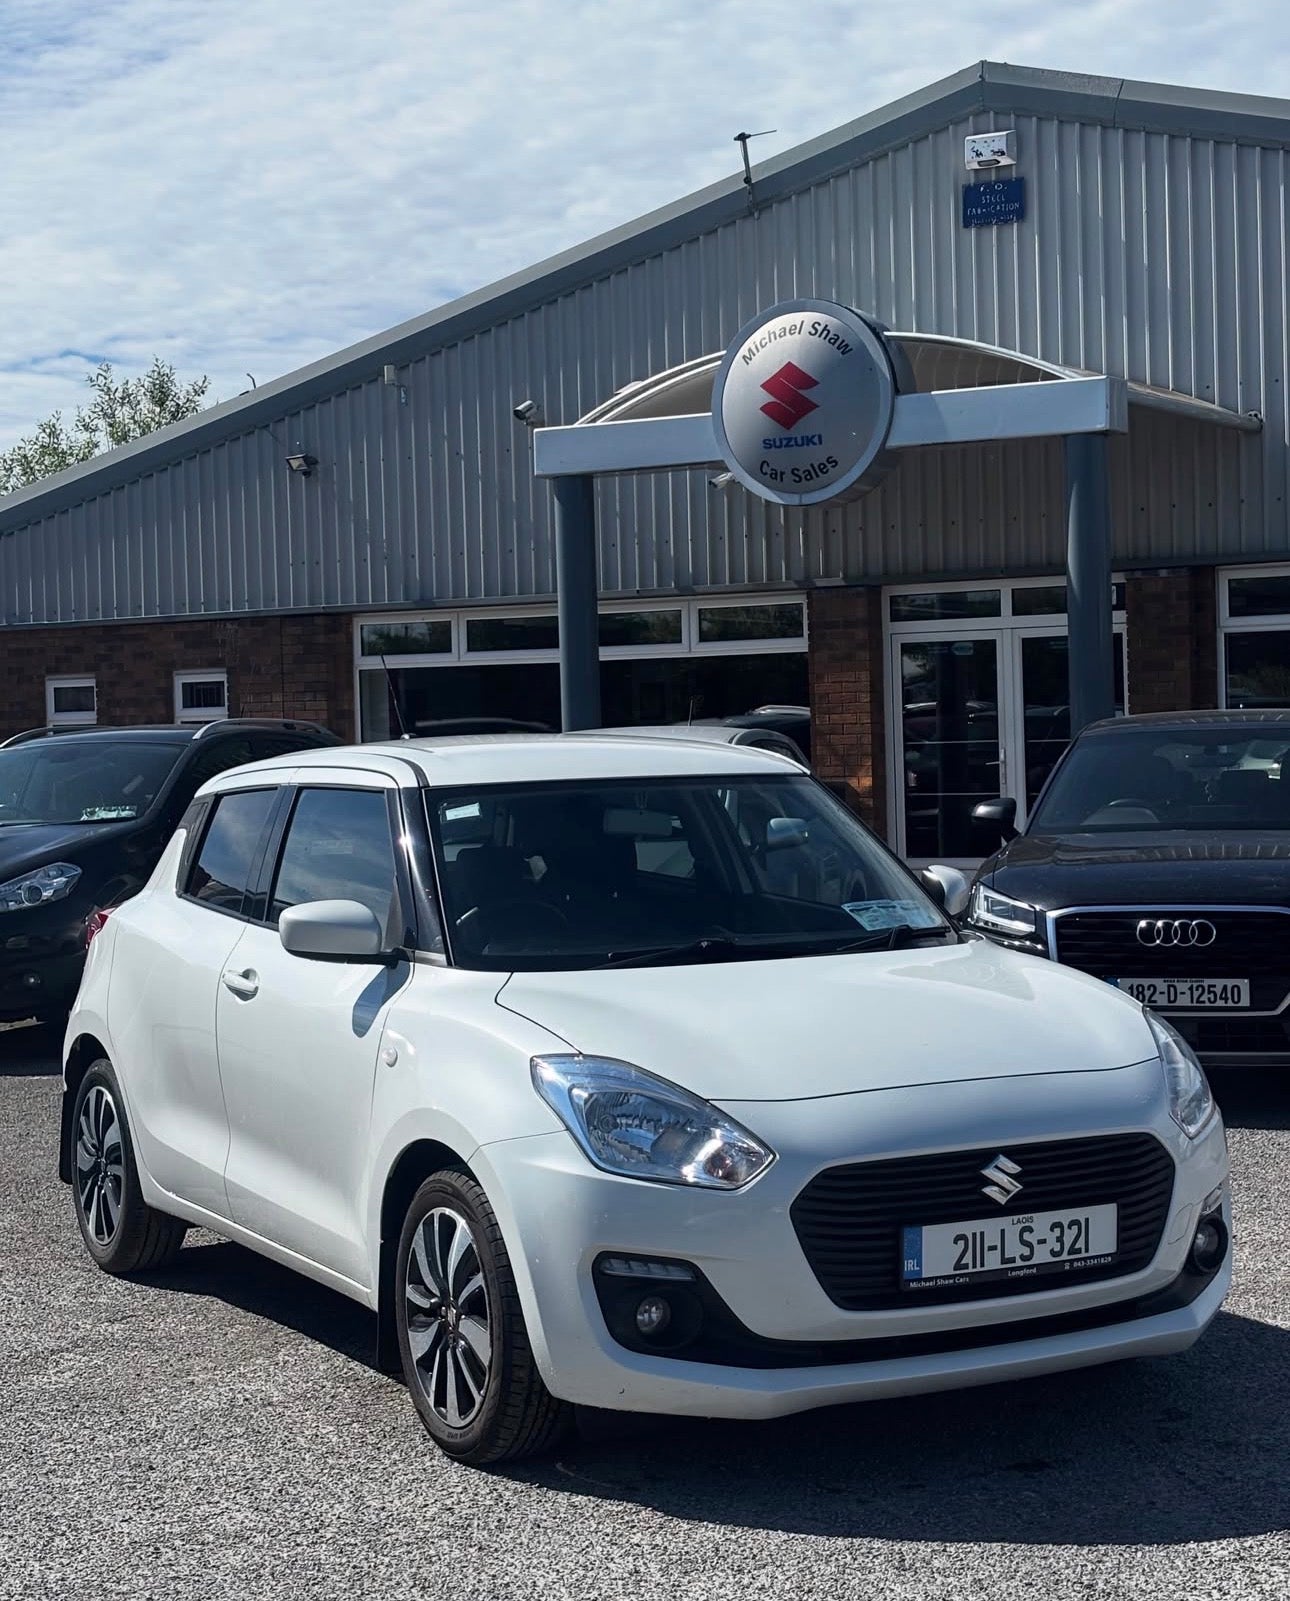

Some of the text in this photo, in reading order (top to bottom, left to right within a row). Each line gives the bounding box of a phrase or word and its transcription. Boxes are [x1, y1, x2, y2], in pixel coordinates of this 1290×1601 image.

[967, 202, 1020, 216] FABCATION
[741, 320, 854, 366] Michael Shaw
[762, 434, 823, 450] SUZUKI
[759, 455, 839, 484] Car Sales
[1127, 983, 1242, 1005] 182-D-12540
[1011, 1215, 1034, 1226] LAOIS
[952, 1217, 1090, 1272] 211-LS-321
[904, 1259, 920, 1272] IRL
[909, 1279, 936, 1288] Michael
[936, 1278, 954, 1287] Shaw
[1008, 1267, 1037, 1278] Longford
